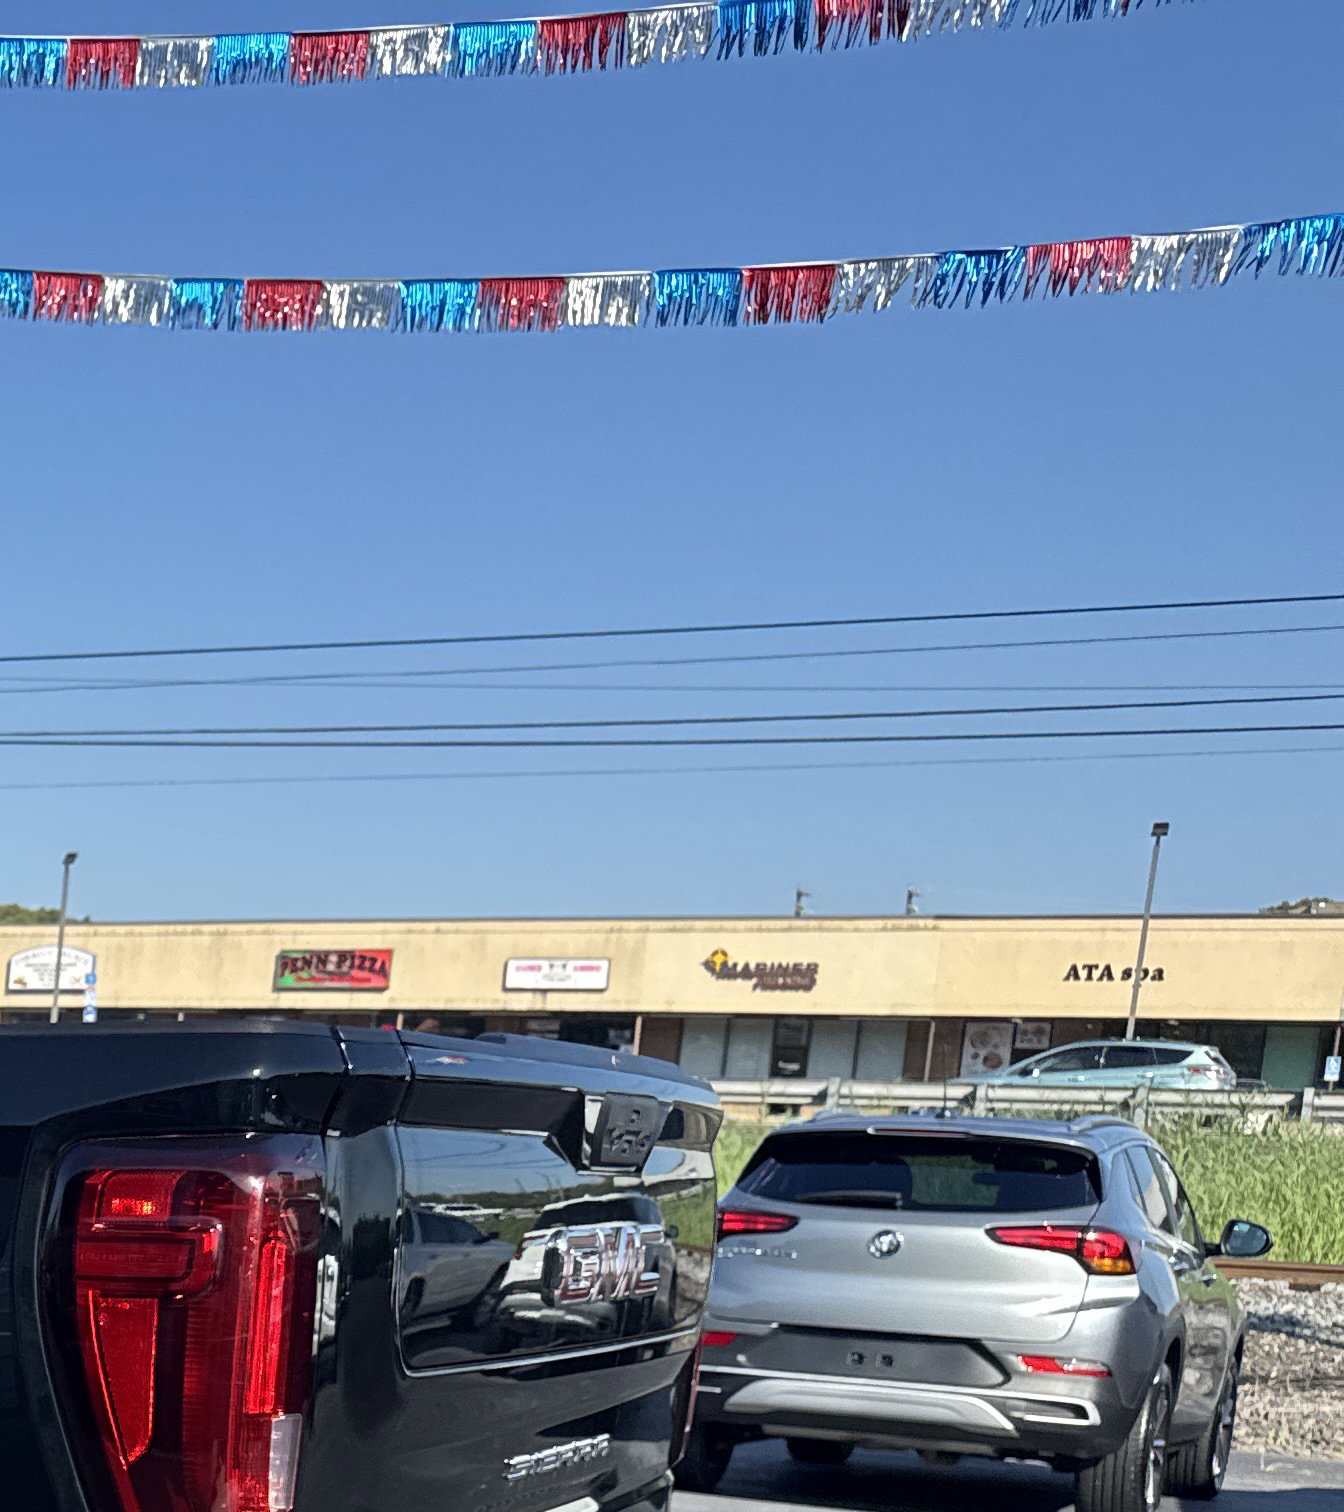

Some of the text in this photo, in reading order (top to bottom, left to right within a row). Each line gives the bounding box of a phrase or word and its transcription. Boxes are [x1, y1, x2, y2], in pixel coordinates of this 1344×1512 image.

[279, 952, 388, 978] PENN PIZZA
[715, 961, 819, 981] MARINER
[1063, 963, 1165, 984] ATA spa
[502, 1433, 611, 1480] SIERRA
